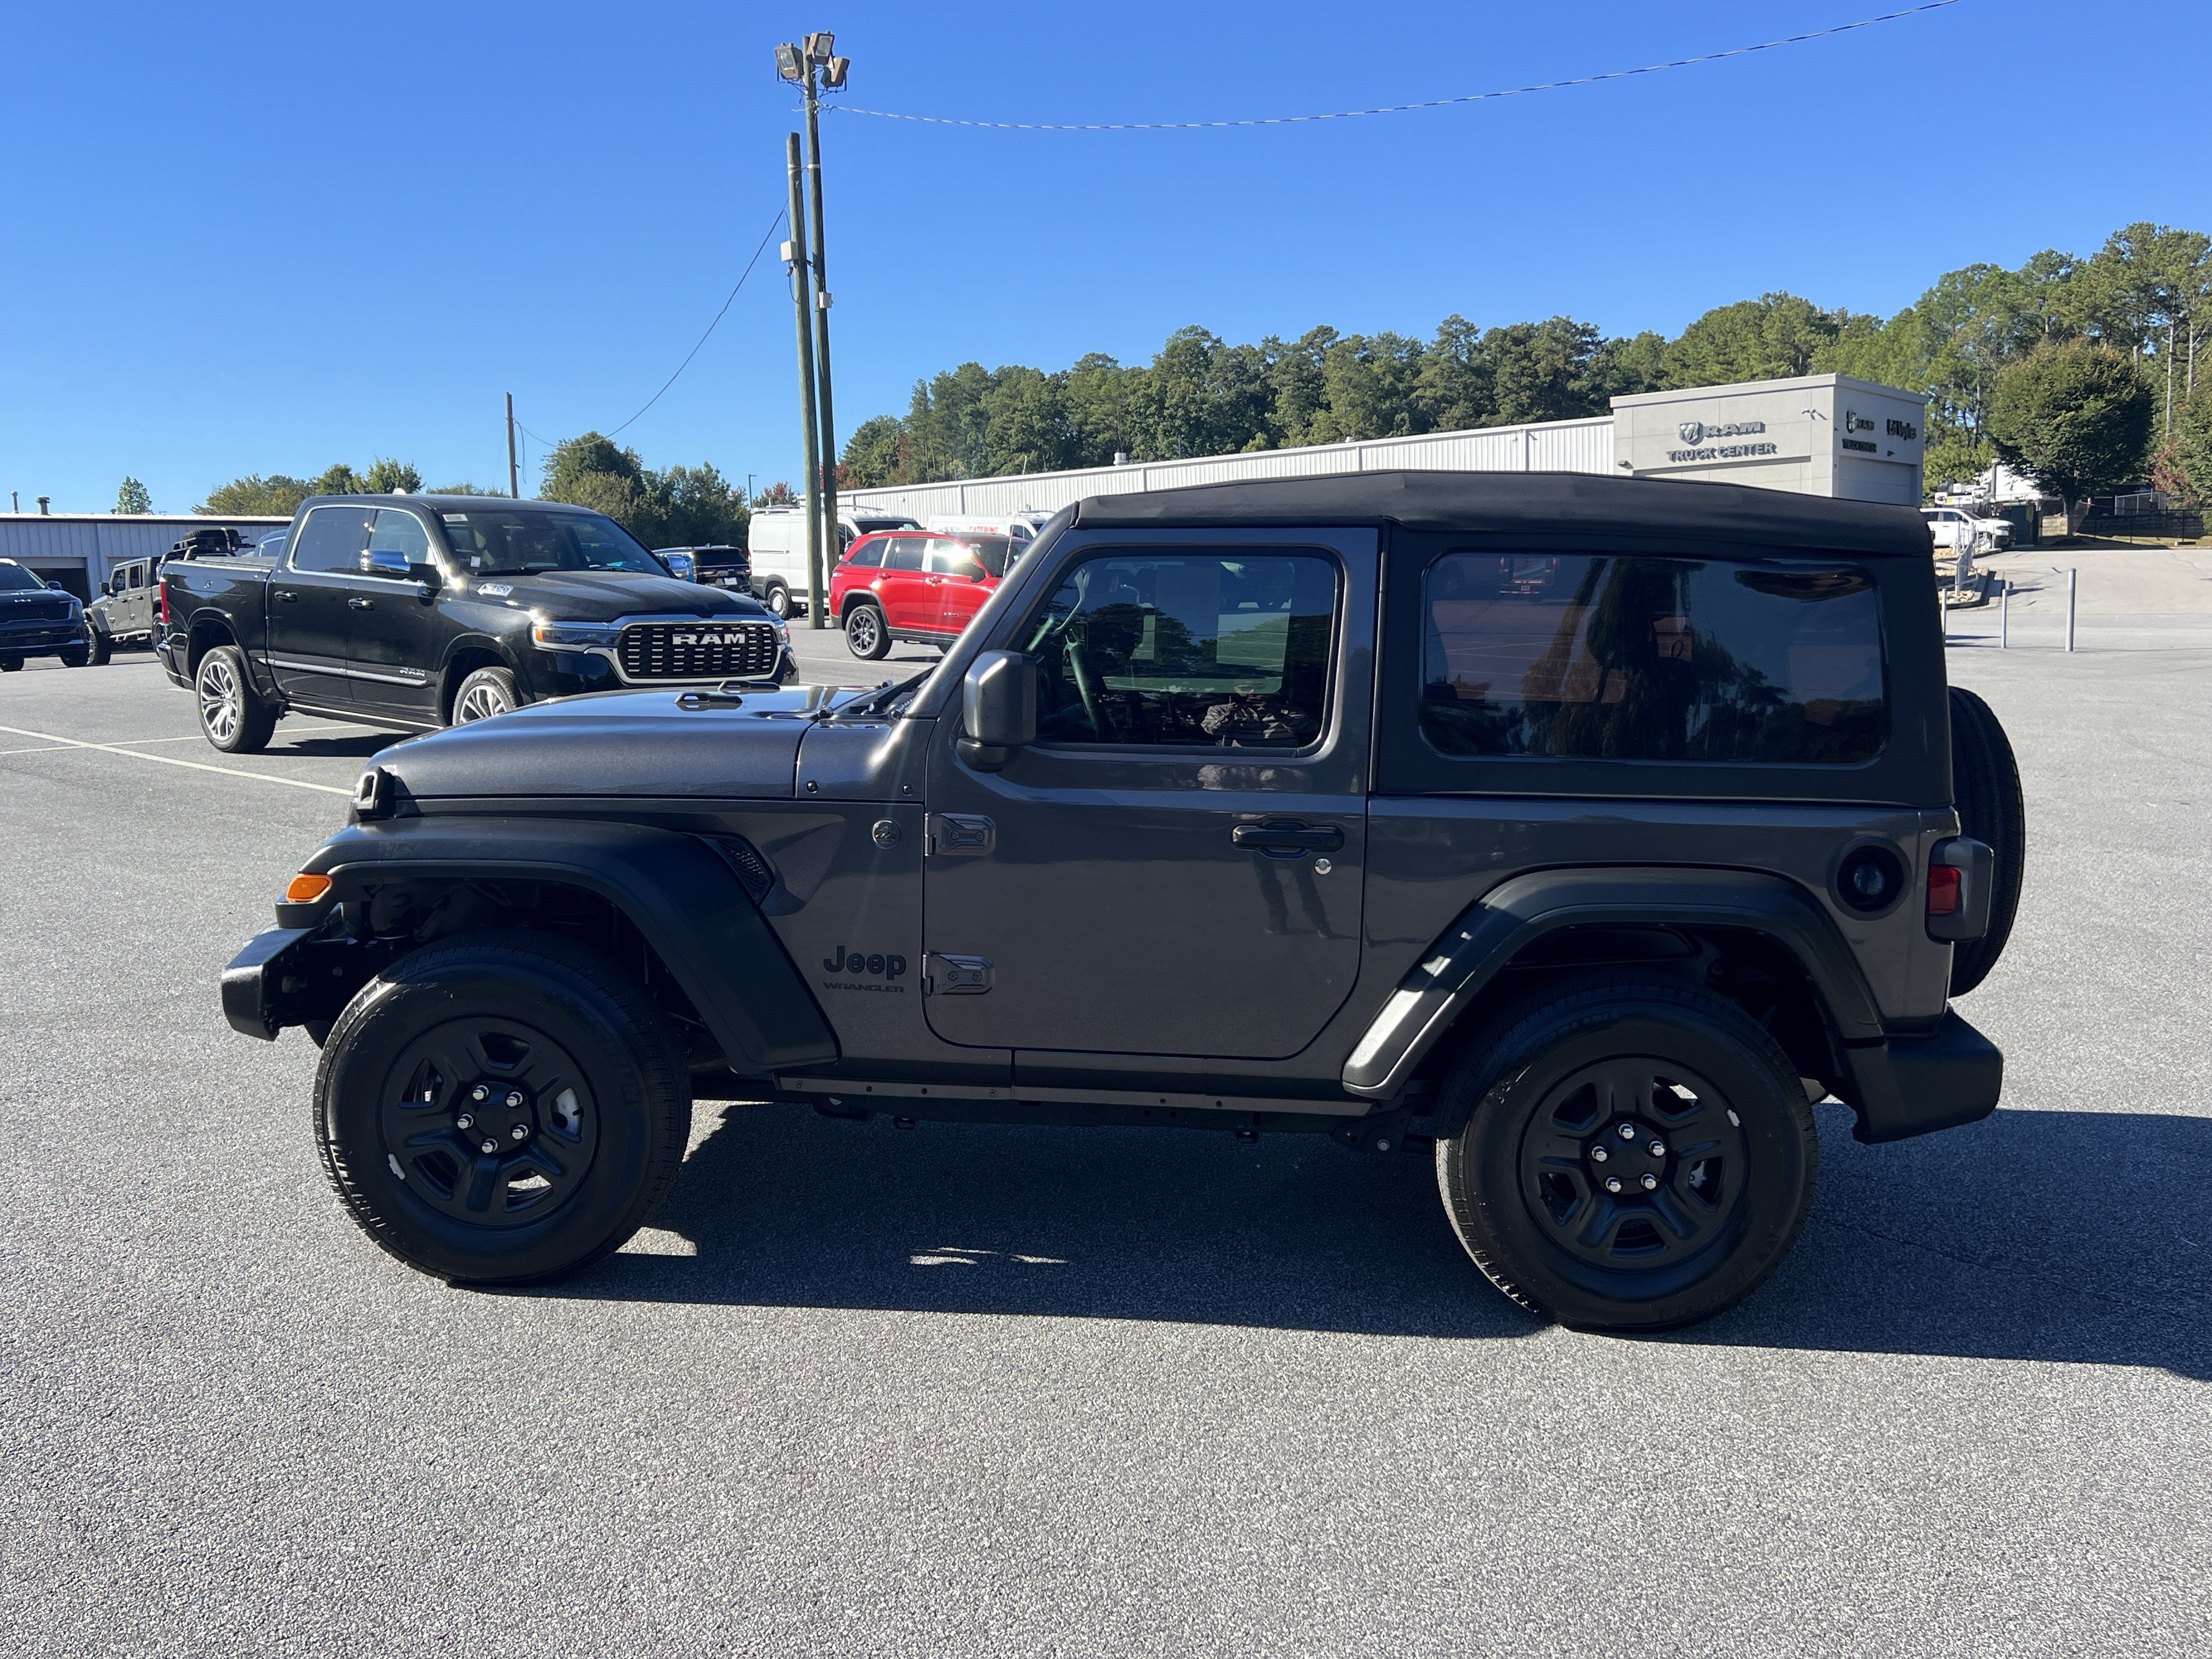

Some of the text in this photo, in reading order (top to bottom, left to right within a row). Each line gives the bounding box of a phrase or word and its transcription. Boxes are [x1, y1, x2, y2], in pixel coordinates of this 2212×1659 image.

[1702, 421, 1763, 436] RAM
[1667, 443, 1776, 462] TRUCK CENTER
[672, 634, 746, 645] RAM
[823, 945, 907, 980] Jeep
[822, 981, 905, 993] WRANGLER
